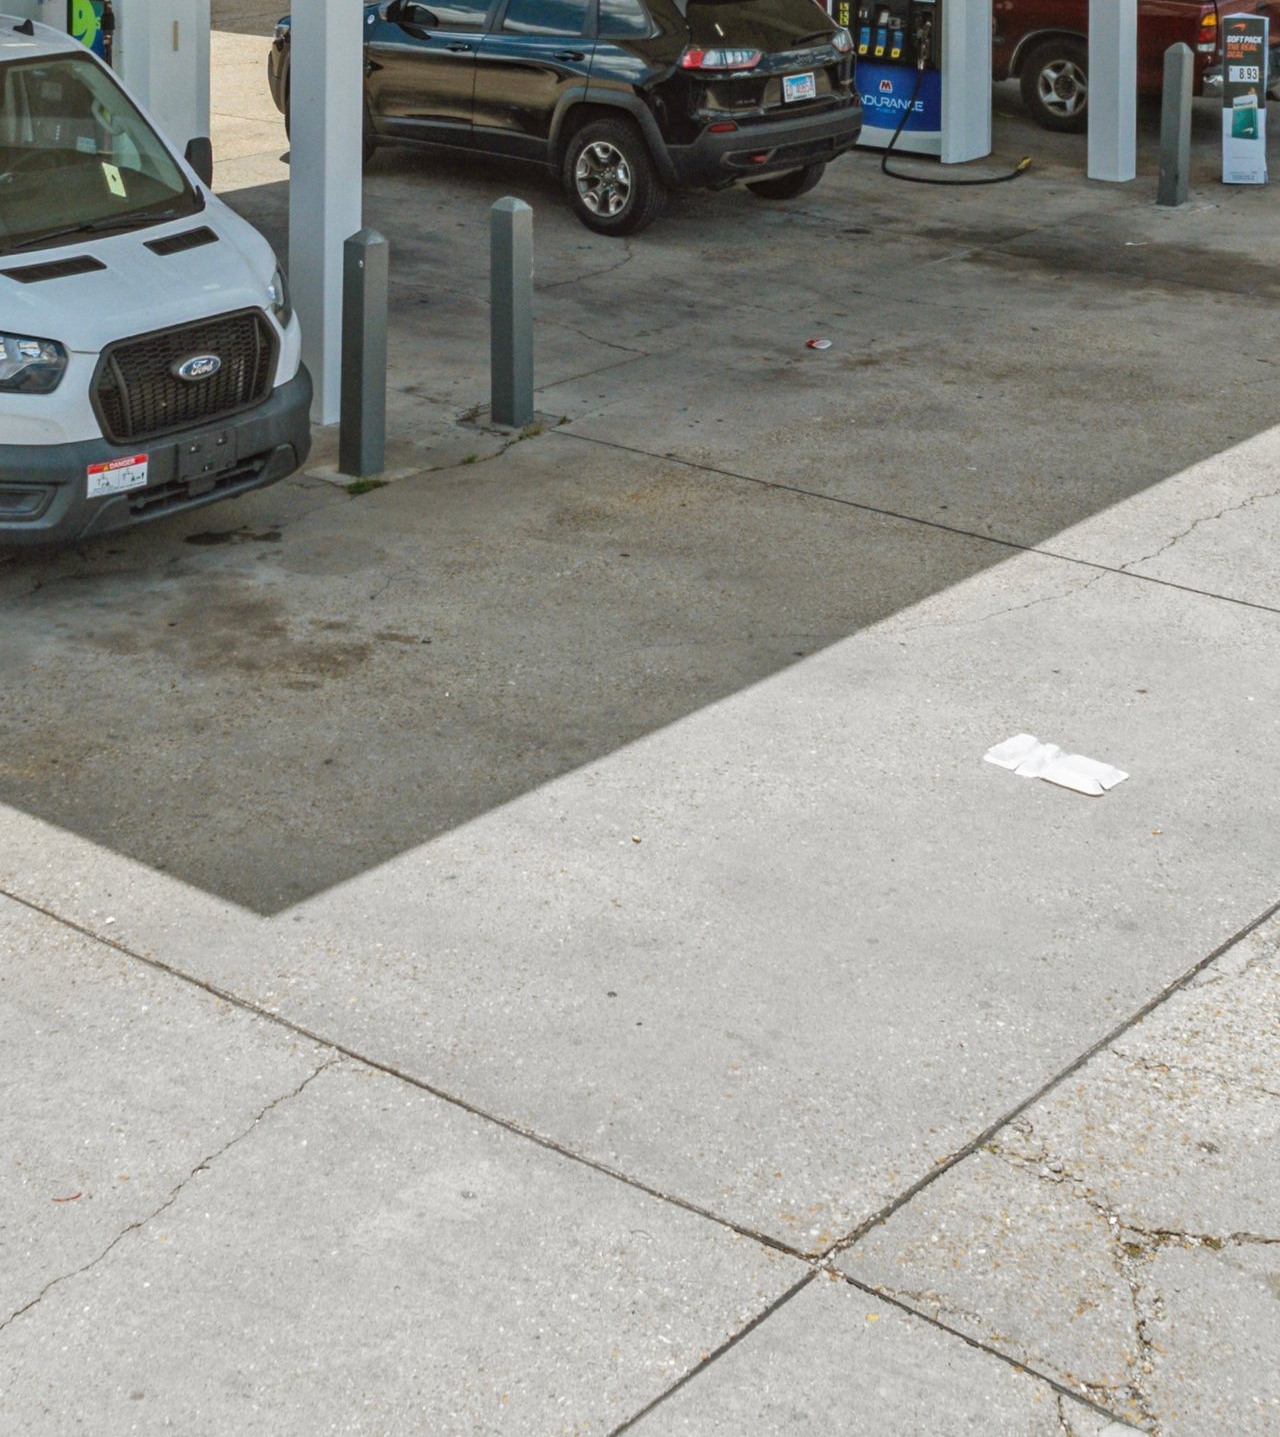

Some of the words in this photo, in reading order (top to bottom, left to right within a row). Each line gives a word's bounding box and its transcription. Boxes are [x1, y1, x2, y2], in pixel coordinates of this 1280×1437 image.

[1227, 35, 1244, 43] SOFT
[1244, 36, 1263, 44] PACK
[1239, 67, 1258, 80] 8.93
[861, 94, 924, 112] NDURANCE
[191, 359, 214, 376] Ford
